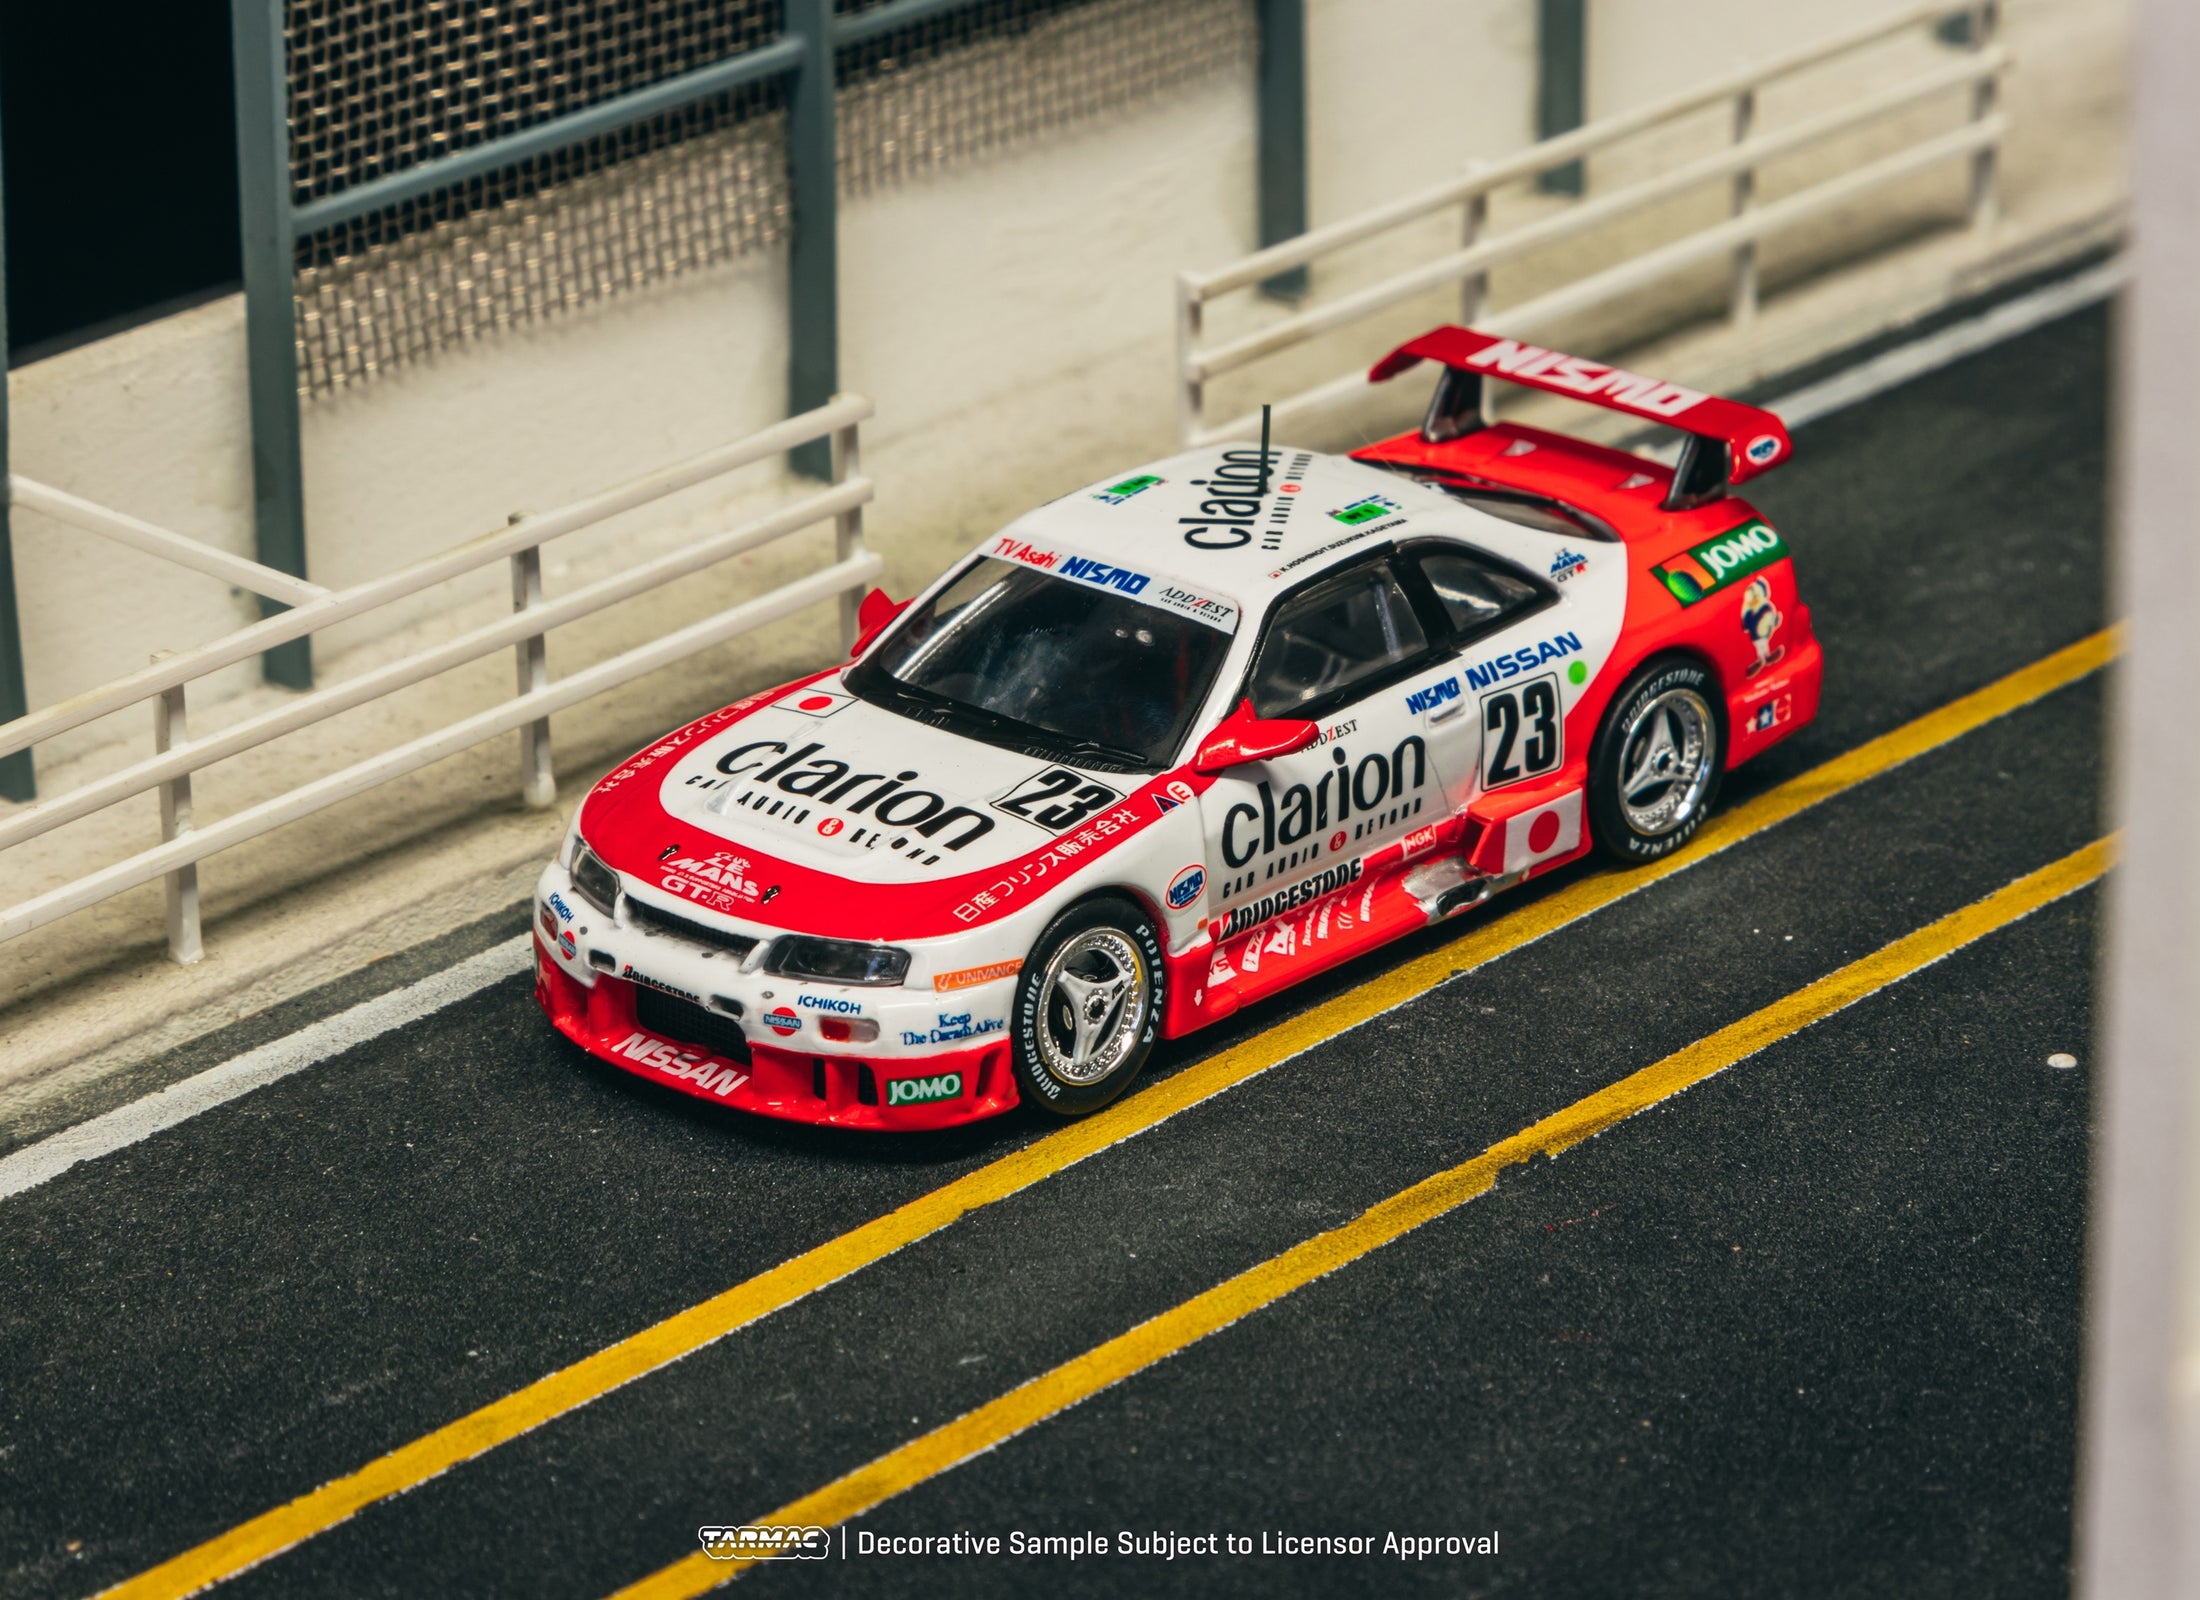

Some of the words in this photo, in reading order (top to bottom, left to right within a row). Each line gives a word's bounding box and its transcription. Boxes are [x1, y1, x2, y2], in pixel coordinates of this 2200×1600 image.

[1466, 339, 1712, 417] NISMO
[993, 537, 1023, 557] TV
[1012, 544, 1062, 569] Asahi
[1058, 555, 1151, 595] NISMO
[1700, 525, 1778, 579] JOMO
[1158, 586, 1234, 617] ADDZEST
[1464, 631, 1583, 692] NISSAN
[1405, 676, 1462, 716] NISMO
[1486, 680, 1560, 785] 23
[715, 741, 996, 852] clarion
[737, 791, 811, 825] AUDIO
[1000, 769, 1117, 831] 23
[1221, 735, 1426, 869] clarion
[1222, 871, 1255, 899] CAR
[1266, 843, 1320, 879] AUDIO
[1355, 797, 1422, 840] BEYOND
[1406, 827, 1434, 851] NGK
[666, 857, 760, 897] MANS
[1219, 856, 1362, 942] BRIDGESTONE
[549, 891, 575, 924] ICHIKOH
[797, 995, 862, 1015] ICHIKOH
[1135, 924, 1164, 1044] POTENZA
[611, 1032, 749, 1096] NISSAN
[888, 1074, 962, 1105] JOMO
